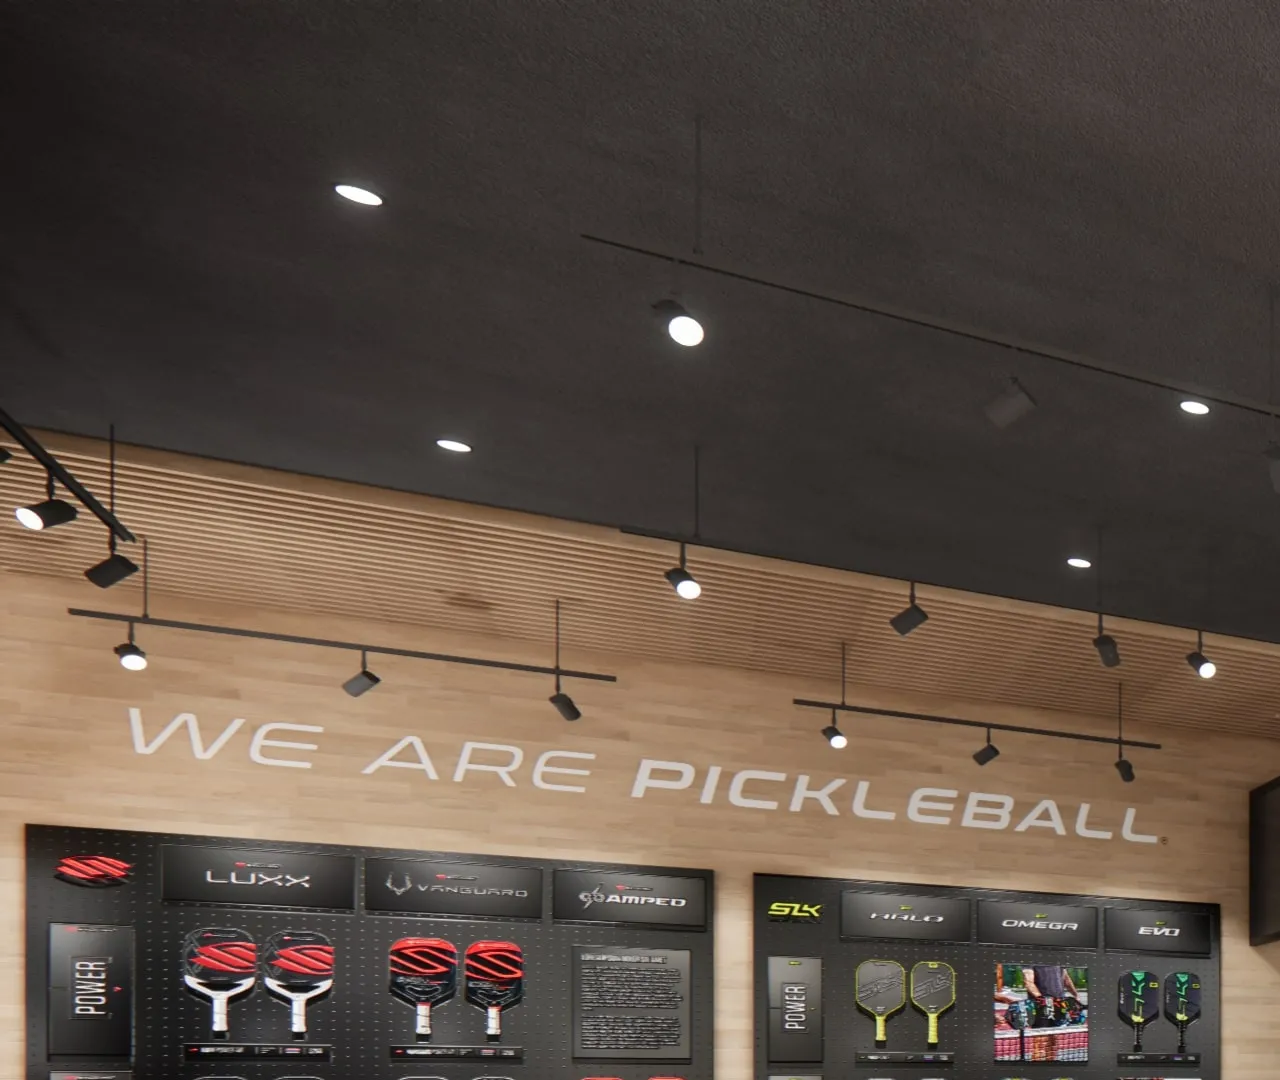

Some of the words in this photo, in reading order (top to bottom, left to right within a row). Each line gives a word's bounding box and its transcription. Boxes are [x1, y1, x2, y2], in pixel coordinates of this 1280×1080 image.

[129, 707, 324, 769] WE
[361, 735, 597, 793] ARE
[630, 758, 1159, 845] PICKLEBALL
[206, 869, 311, 889] LUXX
[417, 884, 529, 899] VANGUARD
[605, 894, 687, 907] AMPED
[767, 902, 824, 917] SLK
[870, 912, 944, 923] HALO
[1001, 919, 1079, 931] OMEGA
[1138, 926, 1180, 937] EVO
[75, 961, 106, 1015] POWER
[784, 986, 806, 1029] POWER
